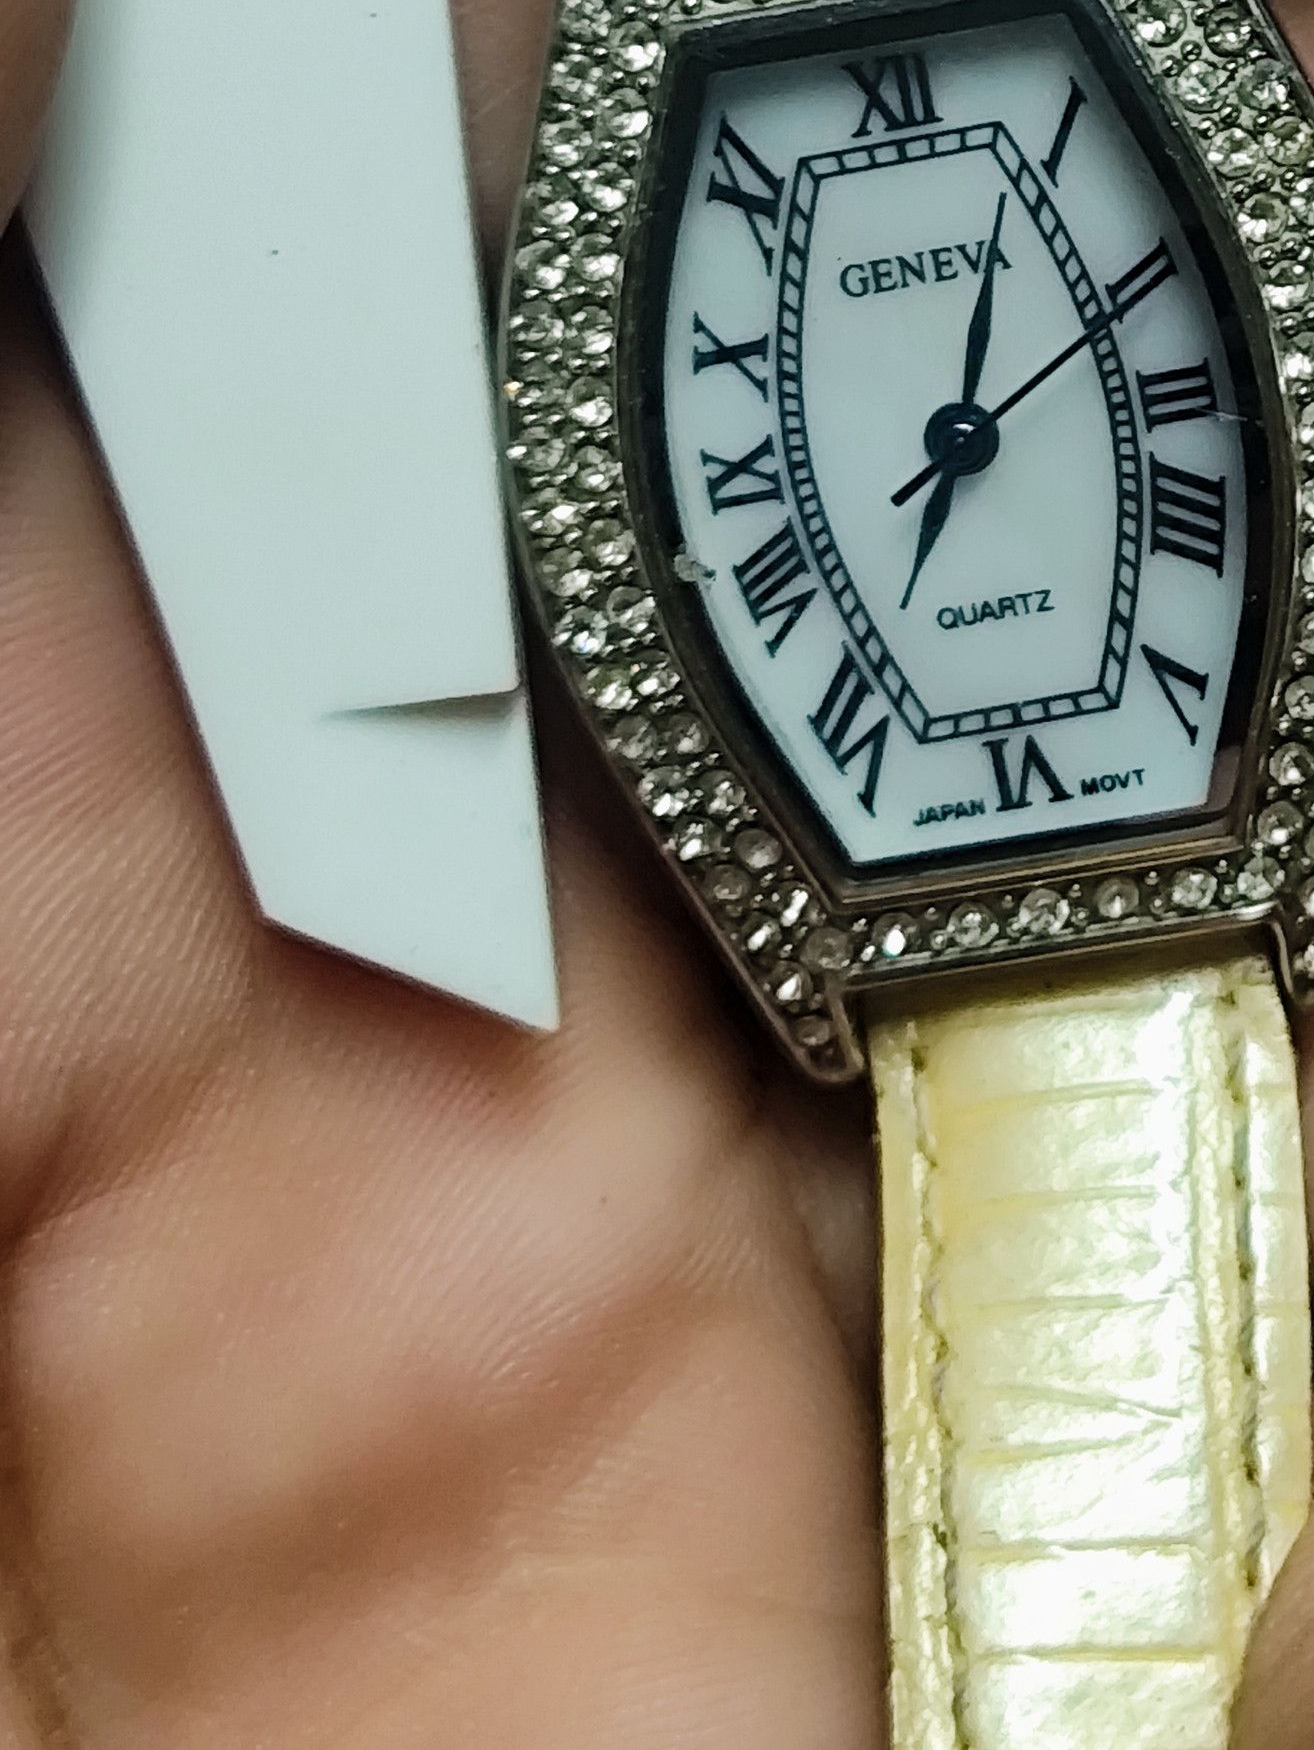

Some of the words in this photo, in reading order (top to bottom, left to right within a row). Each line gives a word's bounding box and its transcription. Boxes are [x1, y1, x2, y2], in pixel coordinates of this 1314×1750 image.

[841, 54, 943, 139] XII
[707, 114, 786, 276] XI
[839, 238, 1014, 300] GENEVA
[1105, 236, 1179, 324] II
[692, 311, 770, 402] X
[1136, 357, 1219, 434] III
[700, 434, 785, 515] IX
[1149, 451, 1227, 578] IIII
[732, 515, 818, 659] VIII
[935, 587, 1056, 631] QUARTZ
[808, 638, 891, 818] VII
[1140, 643, 1210, 746] V
[912, 797, 987, 827] JAPAN
[1079, 767, 1147, 797] MOVT
[981, 734, 1075, 812] VI
